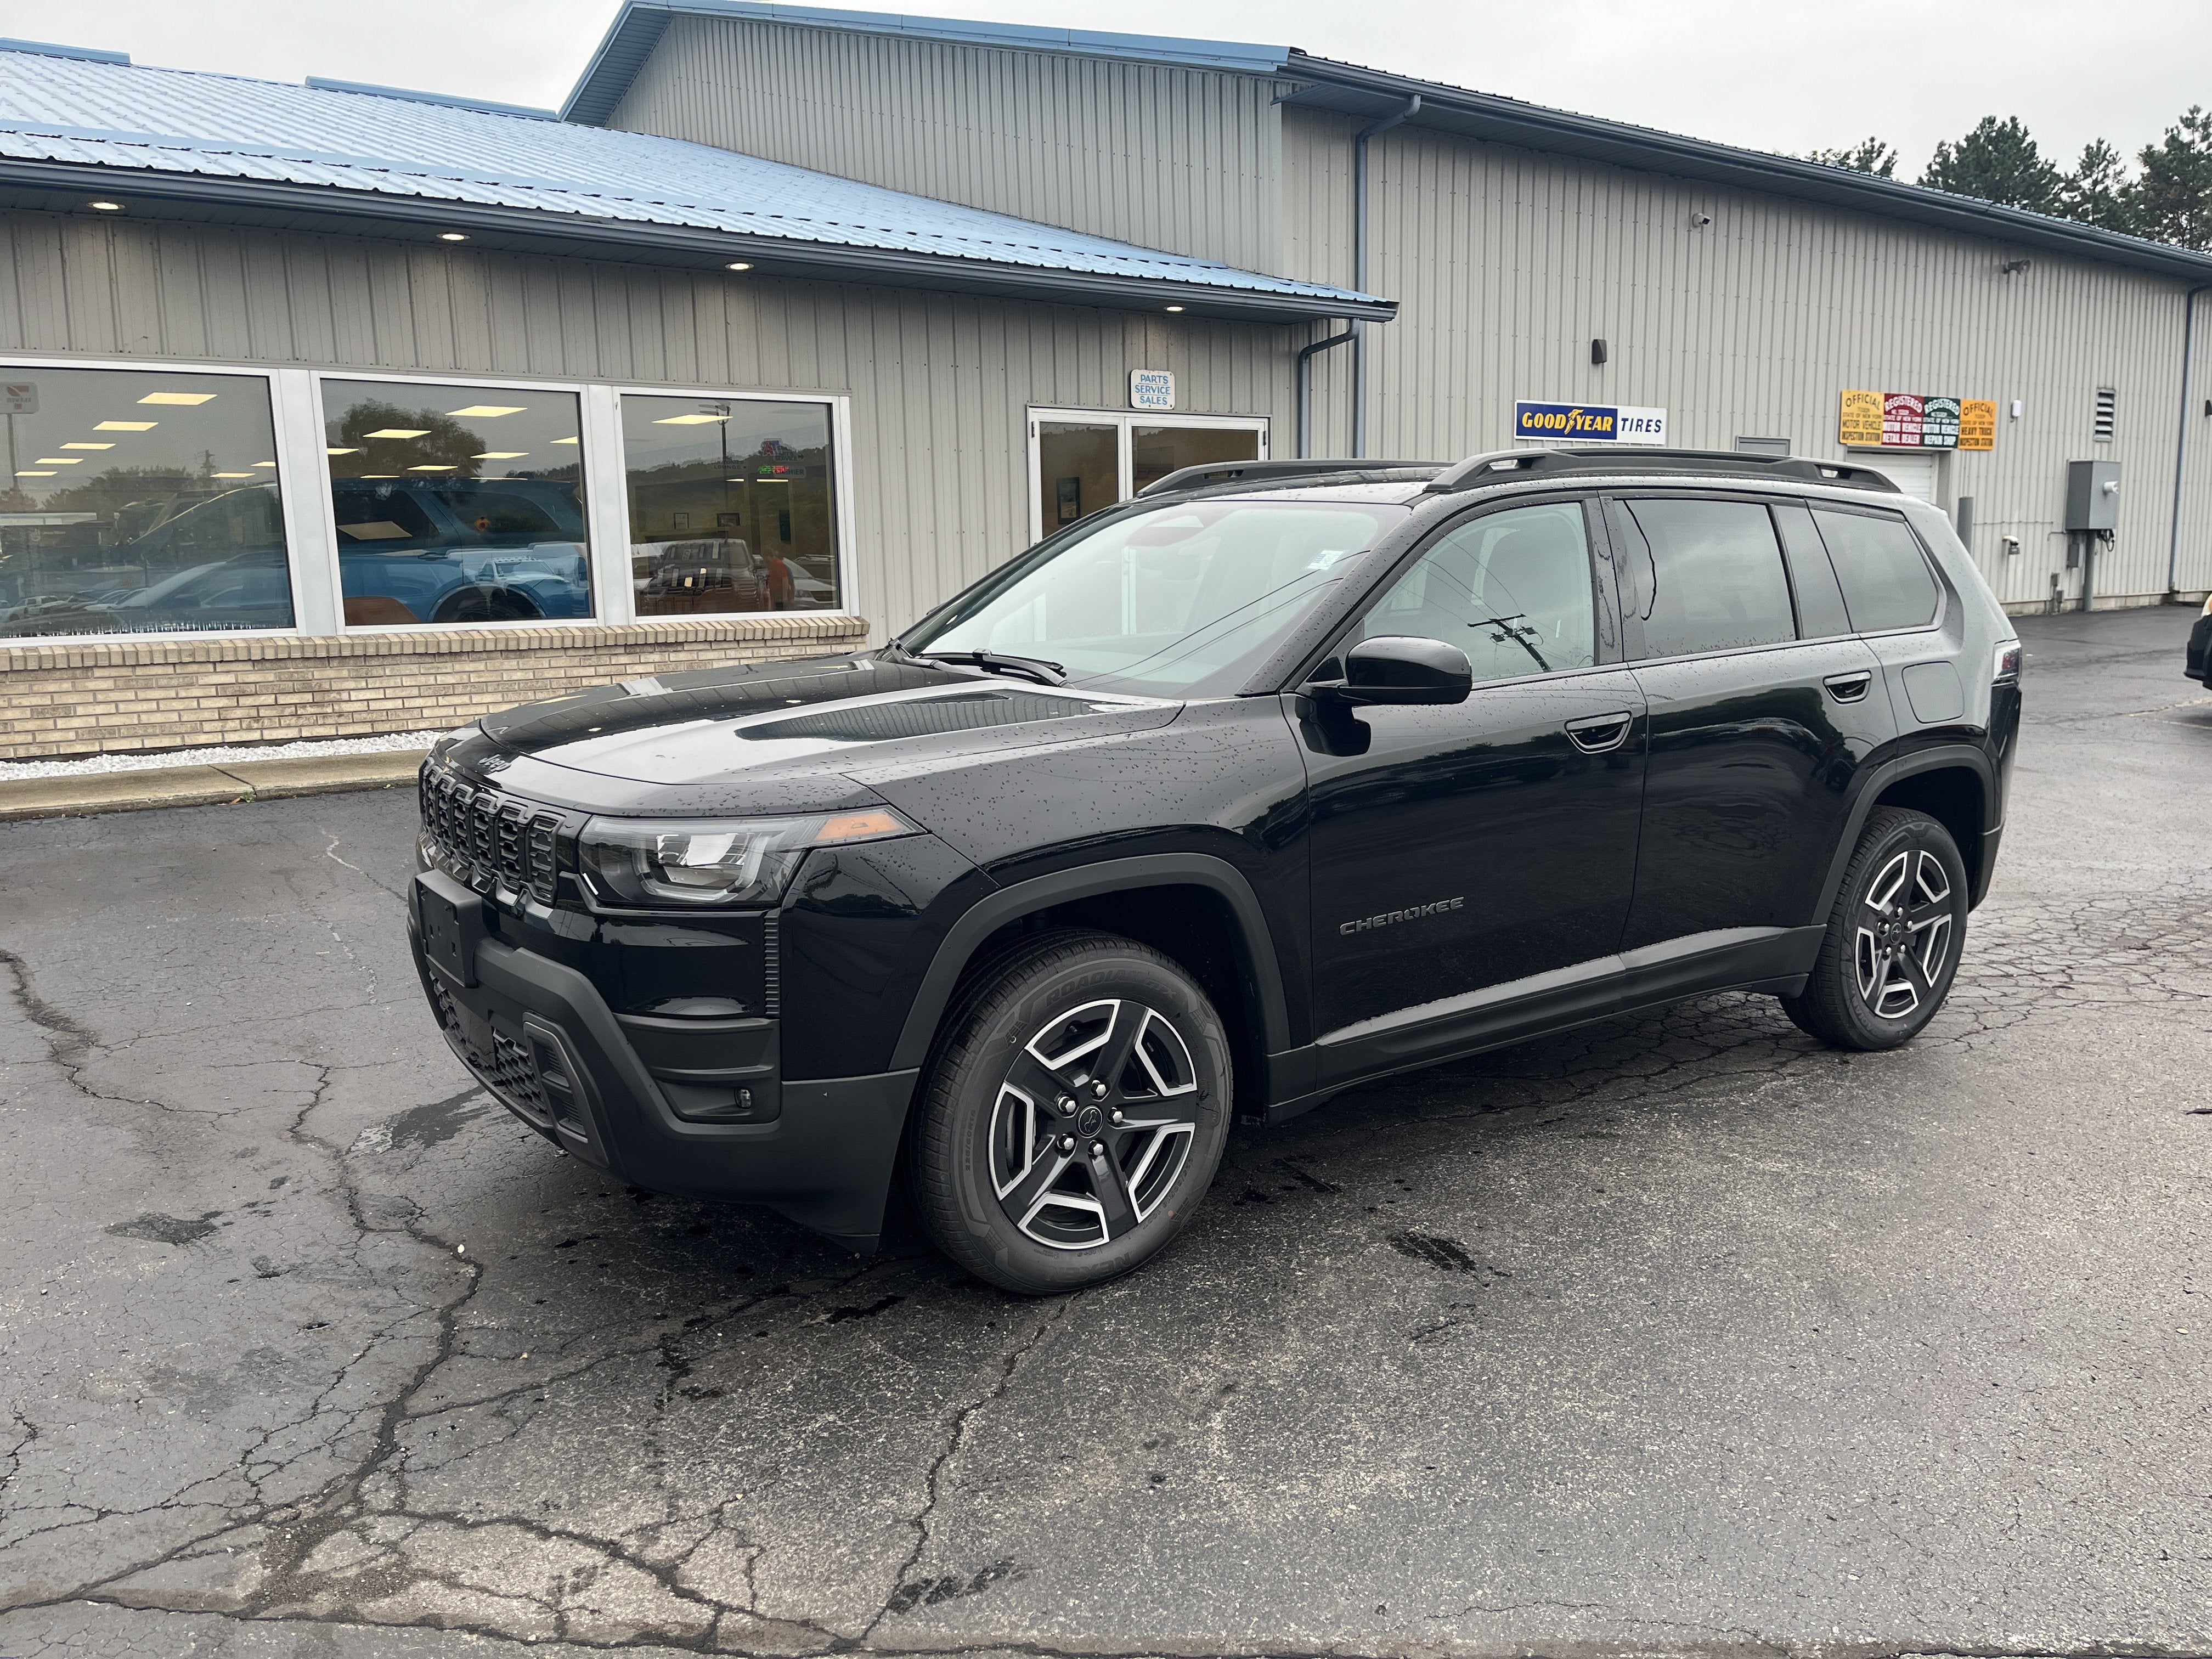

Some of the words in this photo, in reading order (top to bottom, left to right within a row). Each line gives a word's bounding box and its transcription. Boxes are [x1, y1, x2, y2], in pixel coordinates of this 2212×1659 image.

[1141, 374, 1169, 384] PARTS
[1135, 385, 1171, 394] SERVICE
[1140, 396, 1167, 405] SALES
[1846, 394, 1881, 410] OFFICIAL
[1963, 403, 1993, 417] OFFICIAL
[1522, 410, 1614, 432] GOODYEAR
[1621, 417, 1662, 433] TIRES
[1843, 419, 1860, 428] MOTOR
[1863, 420, 1881, 430] VEHICLE
[479, 754, 511, 772] Jeep
[1340, 896, 1464, 935] CHEROKEE
